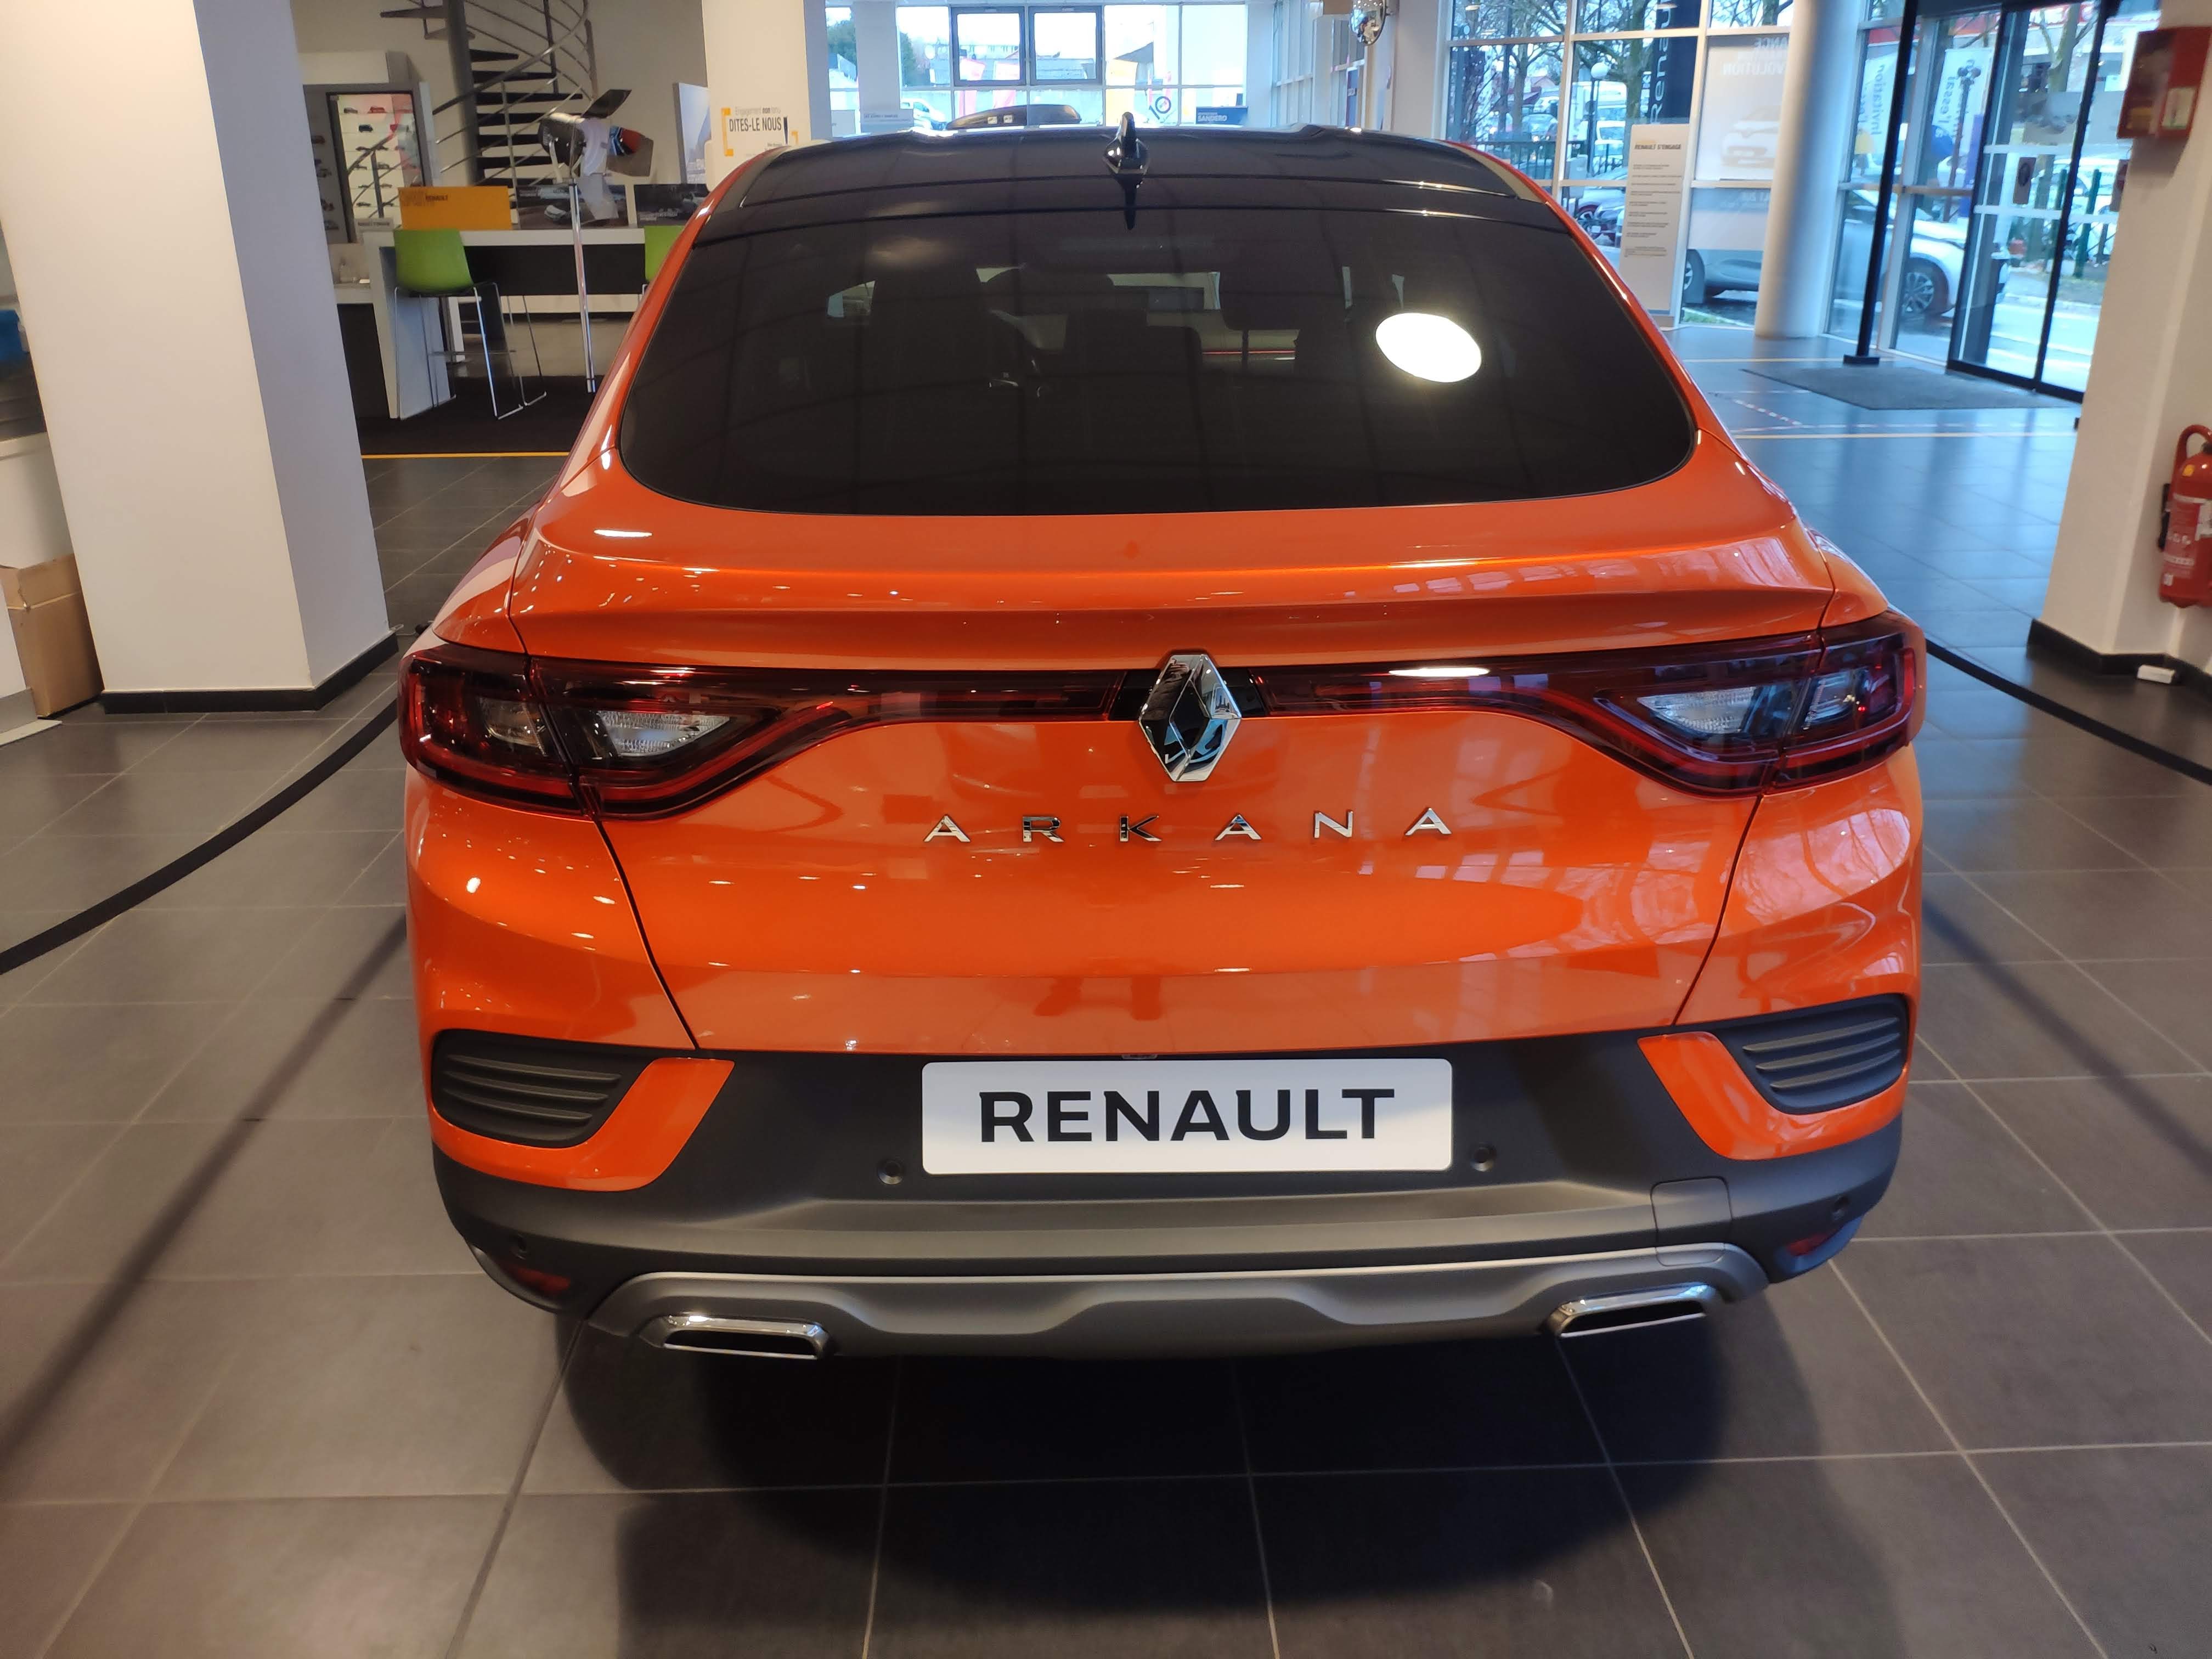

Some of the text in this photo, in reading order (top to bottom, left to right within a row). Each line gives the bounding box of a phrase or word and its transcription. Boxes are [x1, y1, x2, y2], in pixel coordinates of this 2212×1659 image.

[729, 117, 760, 132] DITES-LE
[762, 117, 782, 131] NOUS
[923, 807, 1452, 844] ARKANA
[979, 1088, 1395, 1143] RENAULT
